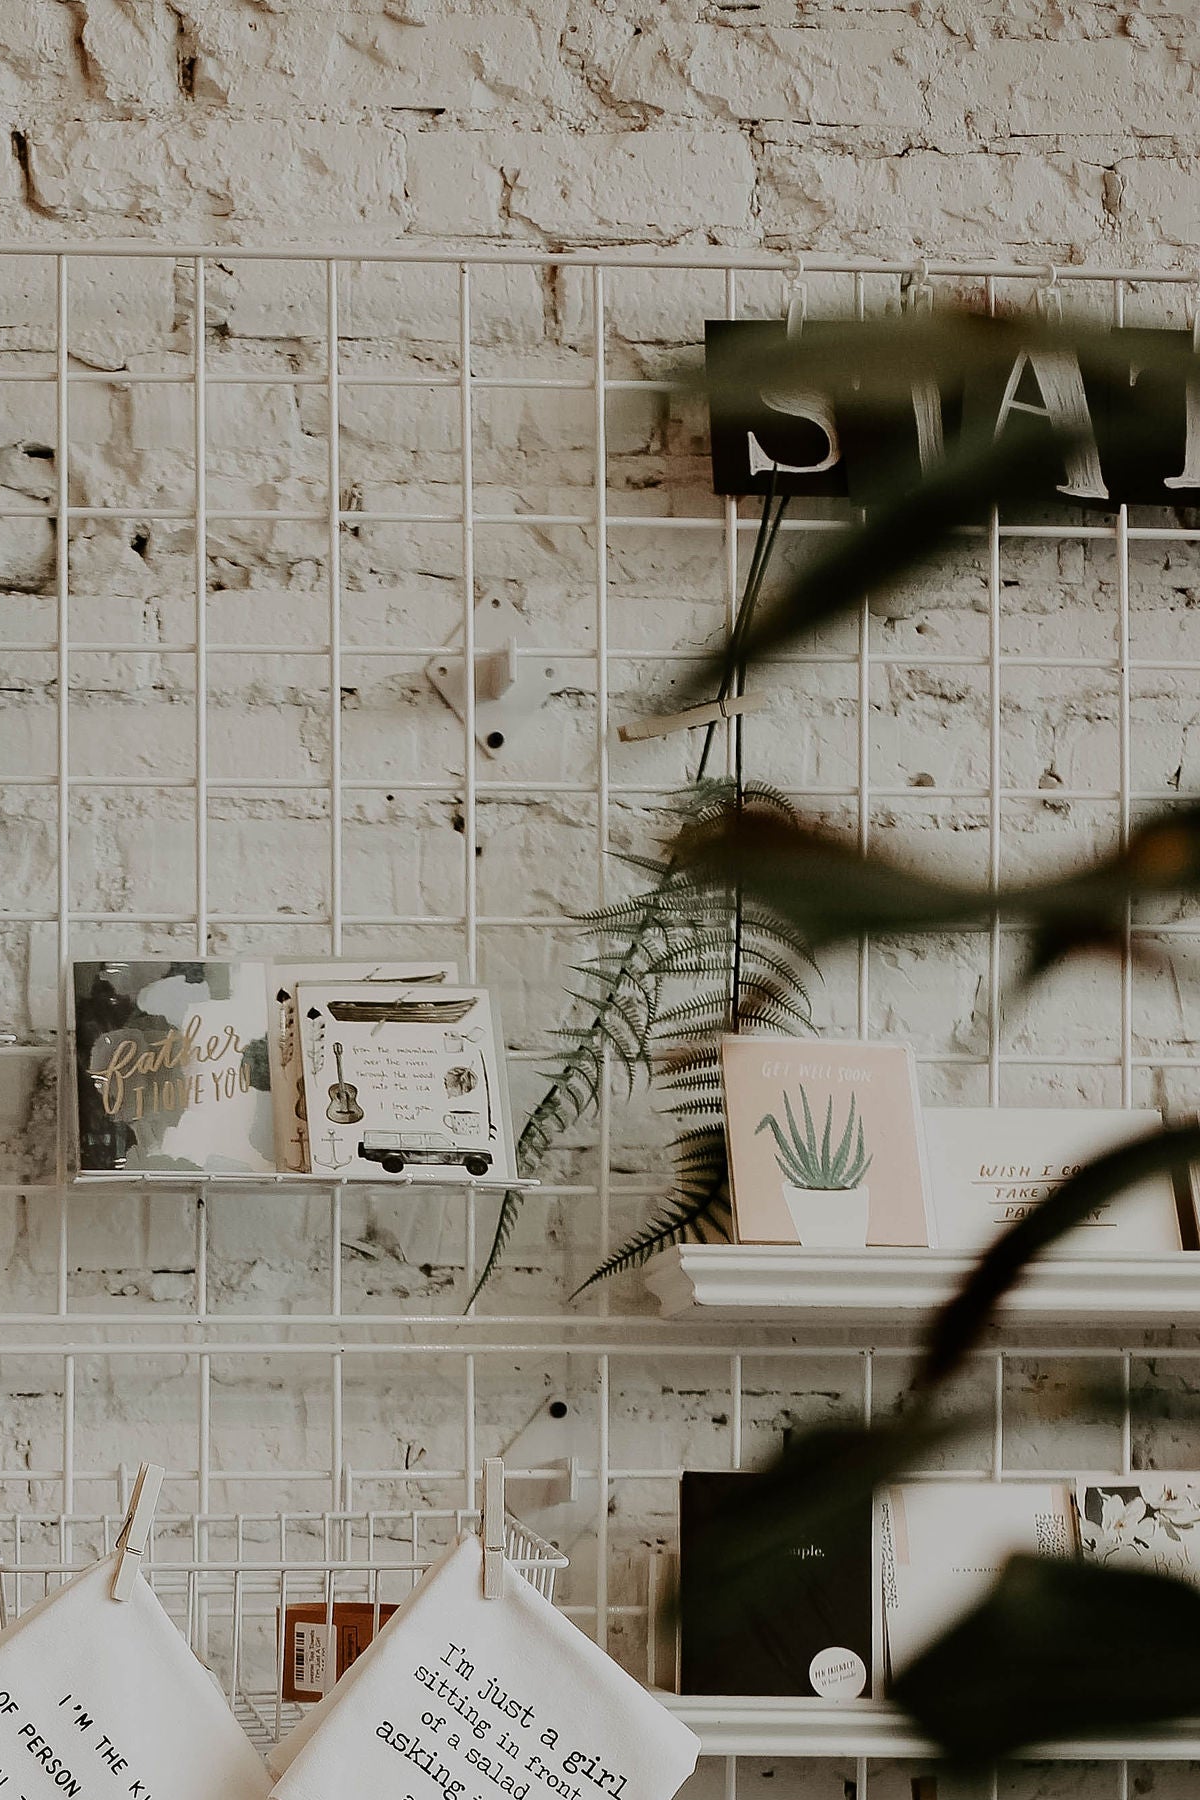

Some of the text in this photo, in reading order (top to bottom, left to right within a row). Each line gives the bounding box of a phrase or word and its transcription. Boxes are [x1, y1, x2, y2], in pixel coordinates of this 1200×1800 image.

[979, 1164, 1031, 1178] WISH
[1041, 1165, 1053, 1176] I
[994, 1186, 1038, 1199] TAKE
[58, 1693, 94, 1733] I'M
[94, 1734, 129, 1776] THE
[413, 1665, 492, 1740] sitting
[495, 1731, 520, 1760] in
[439, 1642, 475, 1682] I'm
[476, 1677, 536, 1729] just
[539, 1727, 559, 1751] a
[17, 1722, 82, 1799] PERSON
